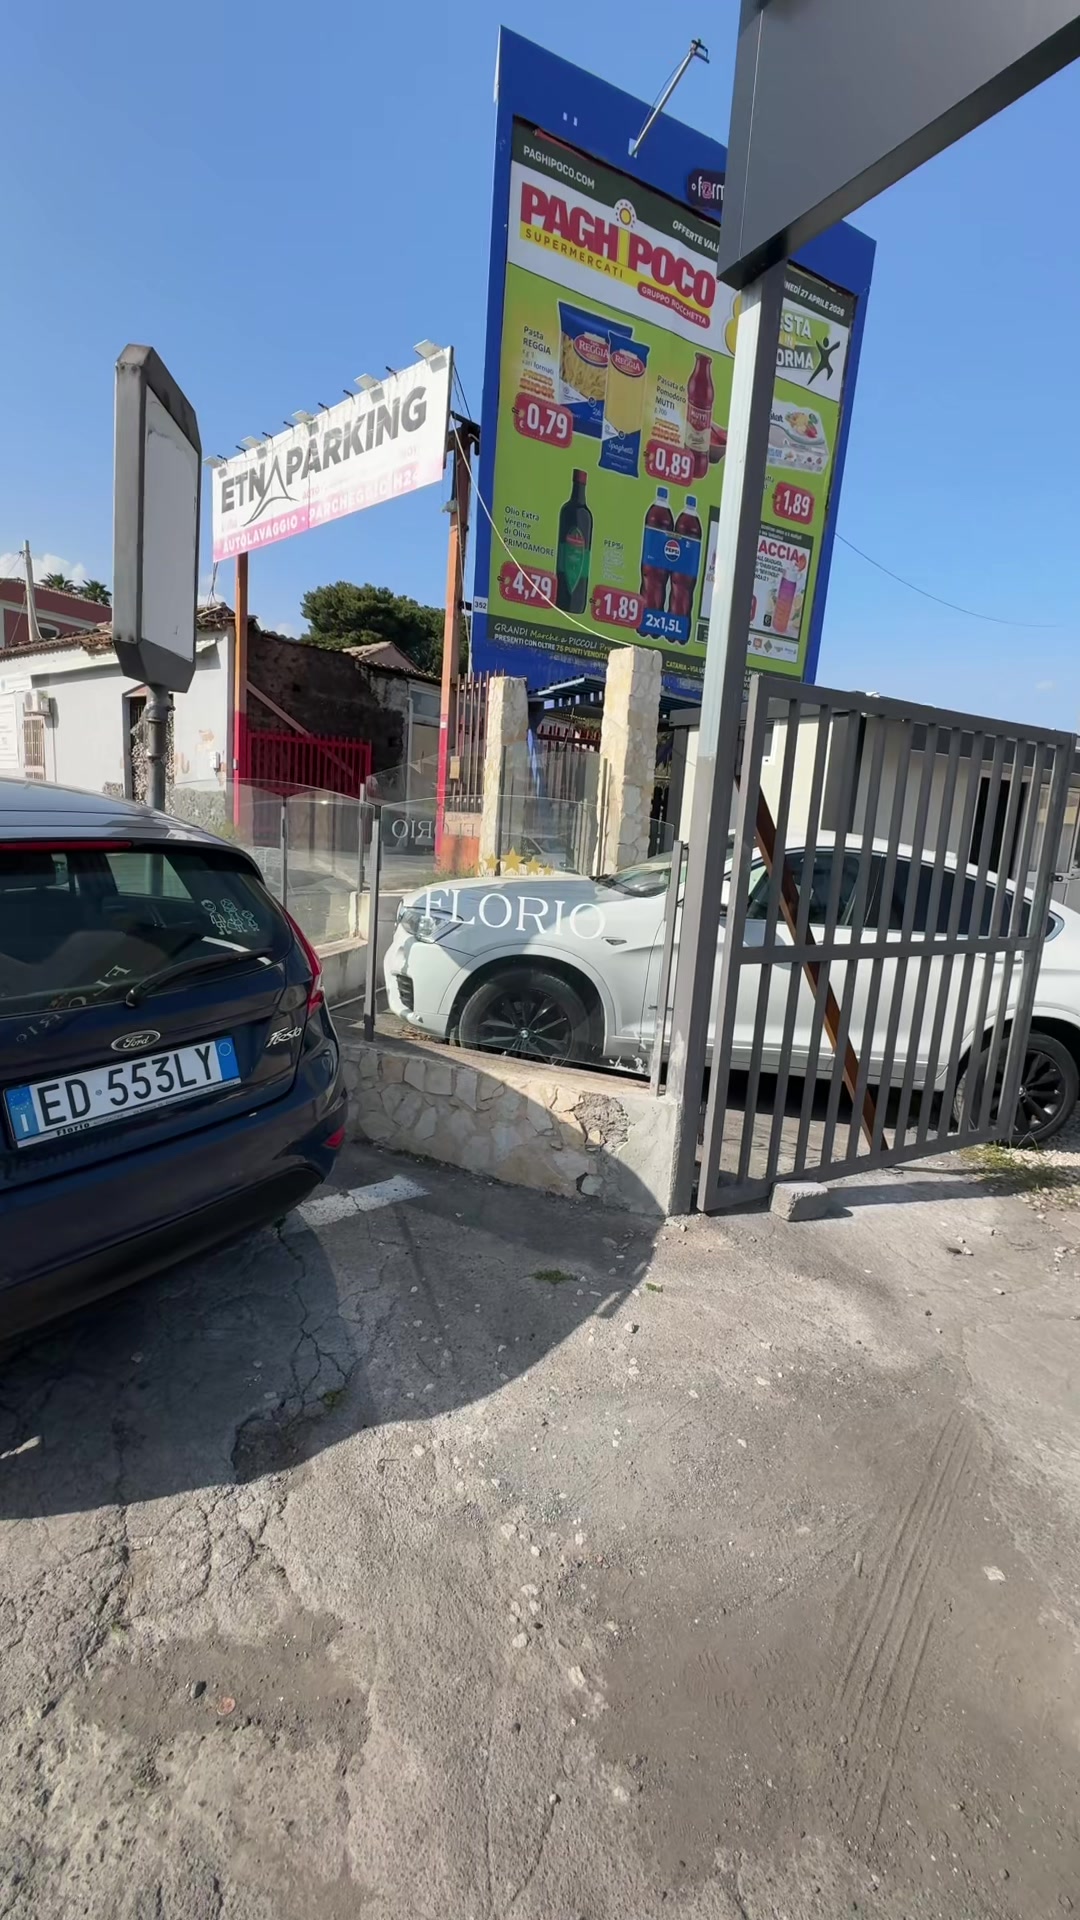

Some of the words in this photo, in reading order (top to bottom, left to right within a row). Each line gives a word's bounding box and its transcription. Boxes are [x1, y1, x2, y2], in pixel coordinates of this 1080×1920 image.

[523, 145, 596, 191] PAGHIPOCO.COM
[672, 220, 704, 246] OFFERTE
[703, 236, 720, 253] VALI
[525, 229, 624, 278] SUPERMERCATI
[641, 286, 670, 306] GRUPPO
[670, 298, 708, 326] ROCCHETTA
[784, 280, 801, 295] NEDÌ
[801, 289, 809, 299] 27
[808, 293, 829, 310] APRILE
[524, 326, 544, 340] Pasta
[523, 338, 551, 355] REGGIA
[579, 339, 609, 360] REGGIA
[615, 354, 640, 371] REGGIA
[776, 348, 814, 370] ORMA
[654, 396, 675, 410] MUTTI
[656, 385, 687, 404] Pomodoro
[527, 404, 568, 439] 0,79
[286, 385, 427, 488] PARKING
[655, 448, 691, 479] 0,89
[505, 506, 520, 515] Olio
[522, 510, 540, 522] Extra
[783, 490, 811, 517] 1,89
[222, 512, 299, 554] AUTOLAVAGGIO
[504, 527, 511, 535] di
[513, 528, 531, 540] Oliva
[505, 517, 531, 530] Vergine
[503, 538, 554, 557] PRIMOAMORE
[665, 547, 680, 555] PEPSI
[759, 540, 800, 564] ACCIA
[512, 571, 552, 601] 4,79
[474, 601, 487, 609] 352
[604, 593, 639, 620] 1,89
[645, 613, 682, 634] 2x1,5L
[494, 622, 528, 636] GRANDI
[530, 629, 559, 642] Marche
[568, 636, 598, 650] PICCOLI
[494, 633, 525, 646] PRESENTI
[524, 640, 538, 648] CON
[537, 641, 556, 651] OLTRE
[556, 644, 564, 652] 75
[564, 646, 583, 657] PUNTI
[583, 649, 609, 661] VENDITA
[424, 886, 607, 940] FLORIO
[122, 1034, 150, 1049] Ford
[265, 1026, 303, 1049] Fiesta
[37, 1077, 92, 1127] ED
[107, 1044, 212, 1108] 553LY
[56, 1121, 91, 1137] Florio
